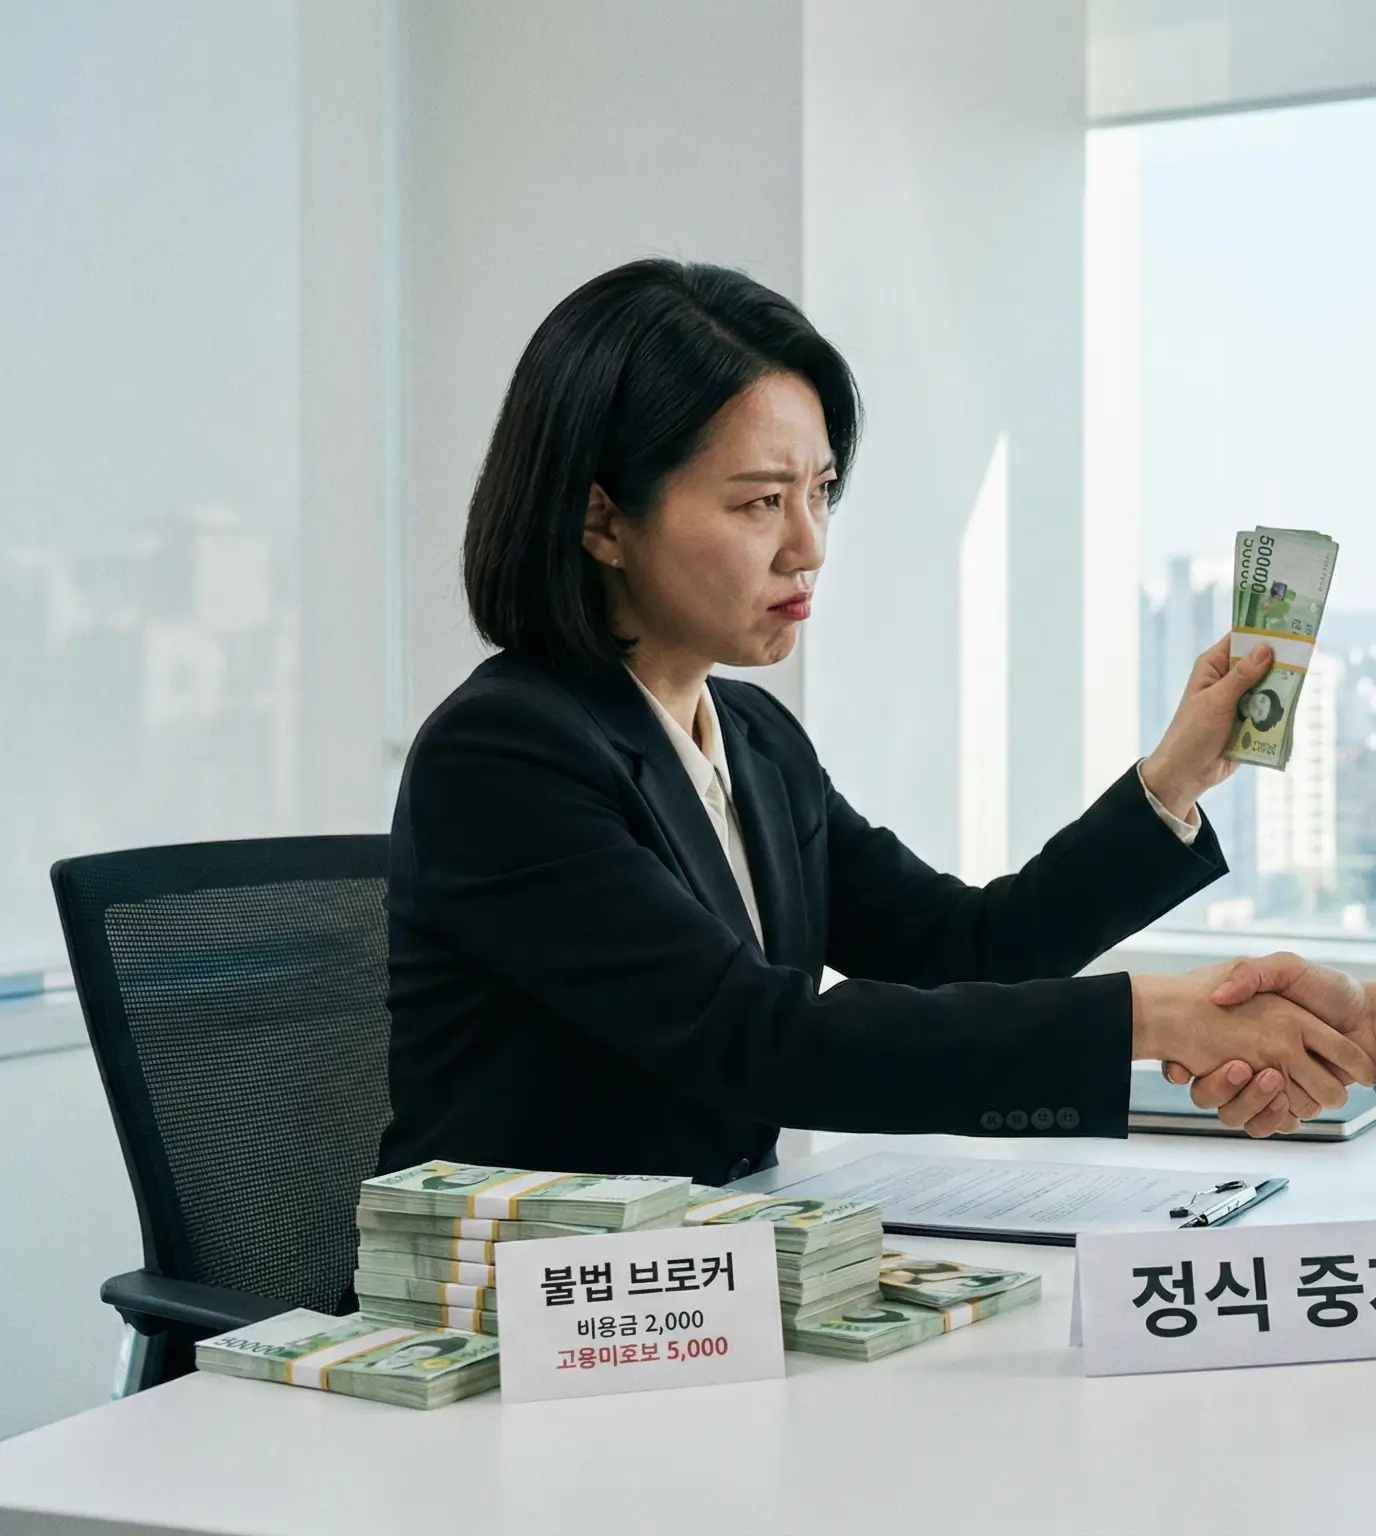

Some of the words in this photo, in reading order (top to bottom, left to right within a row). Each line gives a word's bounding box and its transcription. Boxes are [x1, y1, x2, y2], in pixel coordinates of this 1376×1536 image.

[541, 1262, 614, 1307] 불법
[627, 1251, 736, 1296] 브로커
[1131, 1256, 1270, 1338] 정식
[577, 1315, 638, 1340] 비용금
[644, 1310, 704, 1336] 2,000
[667, 1336, 729, 1362] 5,000
